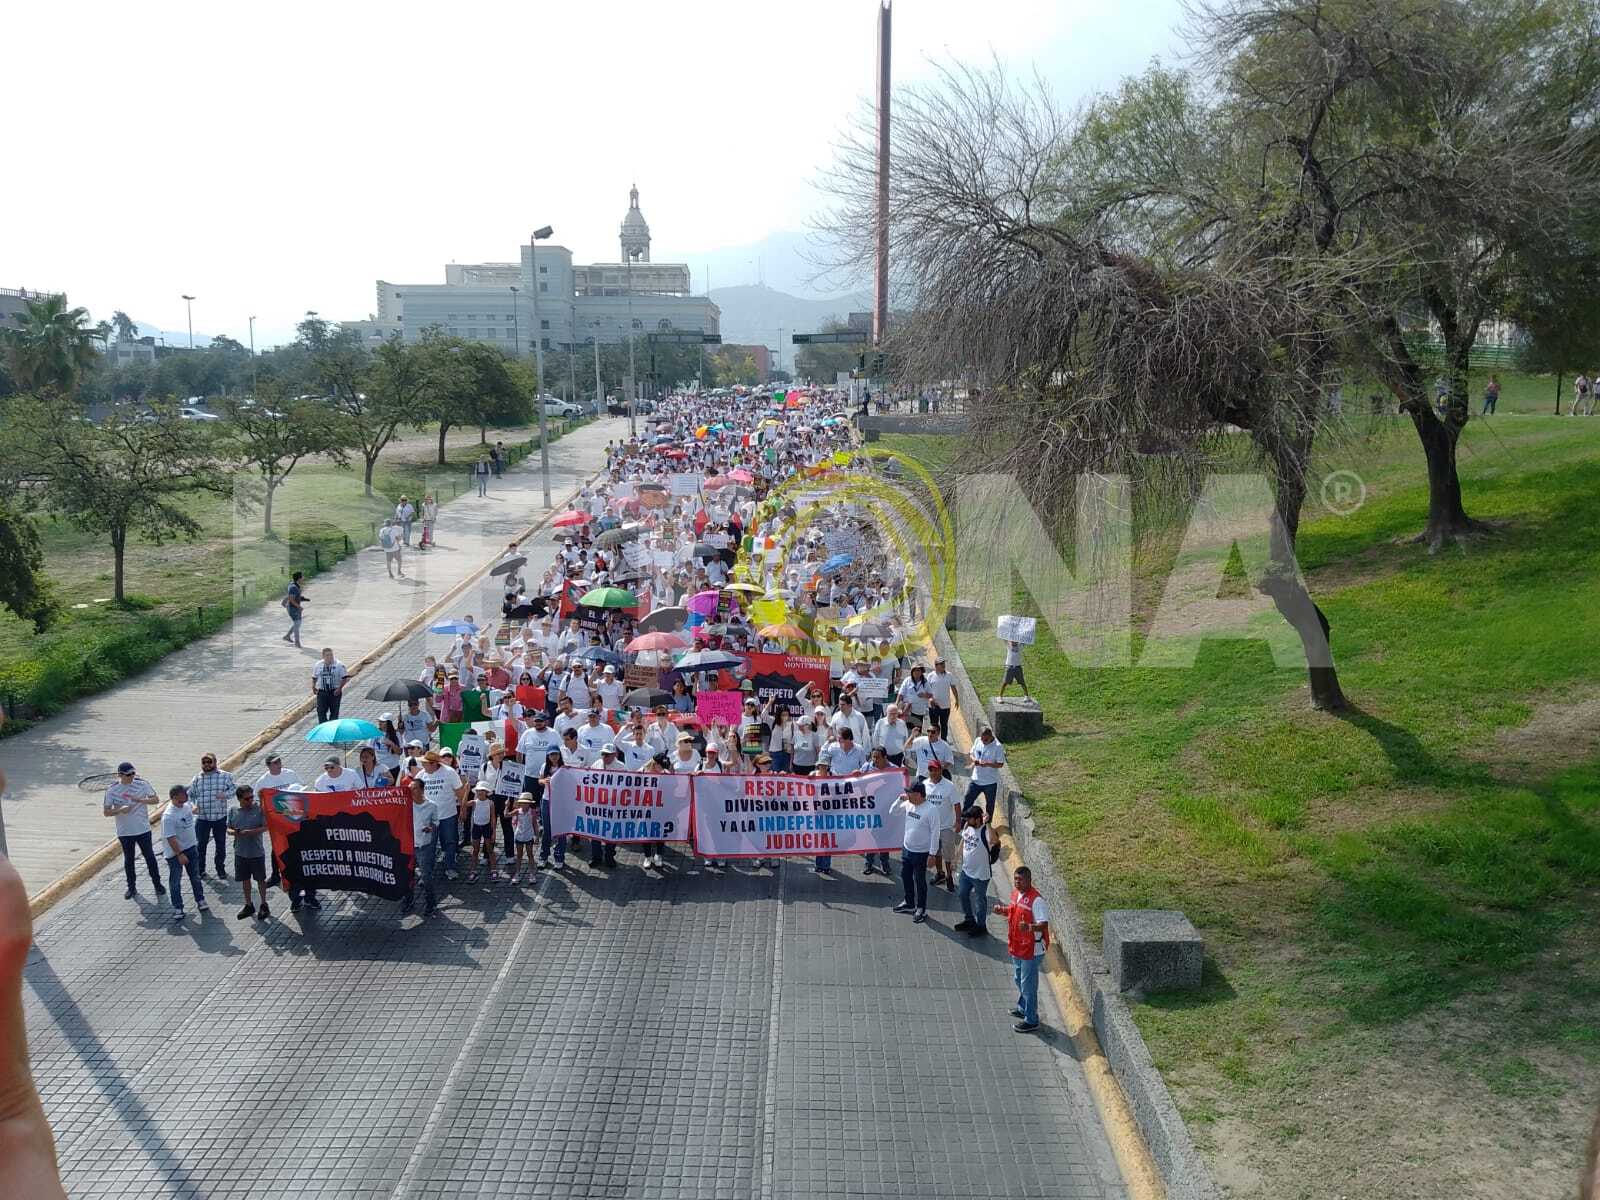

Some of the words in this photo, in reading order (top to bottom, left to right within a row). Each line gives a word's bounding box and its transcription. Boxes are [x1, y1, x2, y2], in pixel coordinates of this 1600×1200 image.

[758, 687, 793, 699] RESPETO
[583, 773, 613, 787] ¿SIN
[617, 776, 658, 788] PODER
[744, 780, 816, 797] RESPETO
[820, 783, 831, 796] A
[835, 781, 854, 795] LA
[575, 784, 664, 808] JUDICIAL
[725, 798, 789, 813] DIVISIÓN
[792, 800, 809, 812] DE
[814, 795, 876, 811] PODERES
[585, 805, 614, 818] QUIEN
[616, 809, 628, 819] TE
[630, 809, 643, 820] VA
[645, 809, 652, 819] A
[575, 815, 674, 839] AMPARAR?
[720, 820, 729, 833] Y
[730, 821, 738, 833] A
[741, 820, 756, 833] LA
[758, 814, 883, 832] INDEPENDENCIA
[326, 828, 372, 843] PEDIMOS
[765, 832, 838, 850] JUDICIAL
[300, 849, 344, 862] RESPETO
[345, 851, 353, 862] A
[354, 851, 393, 869] NUESTROS
[302, 863, 352, 877] DERECHOS
[354, 865, 397, 885] LABORALES
